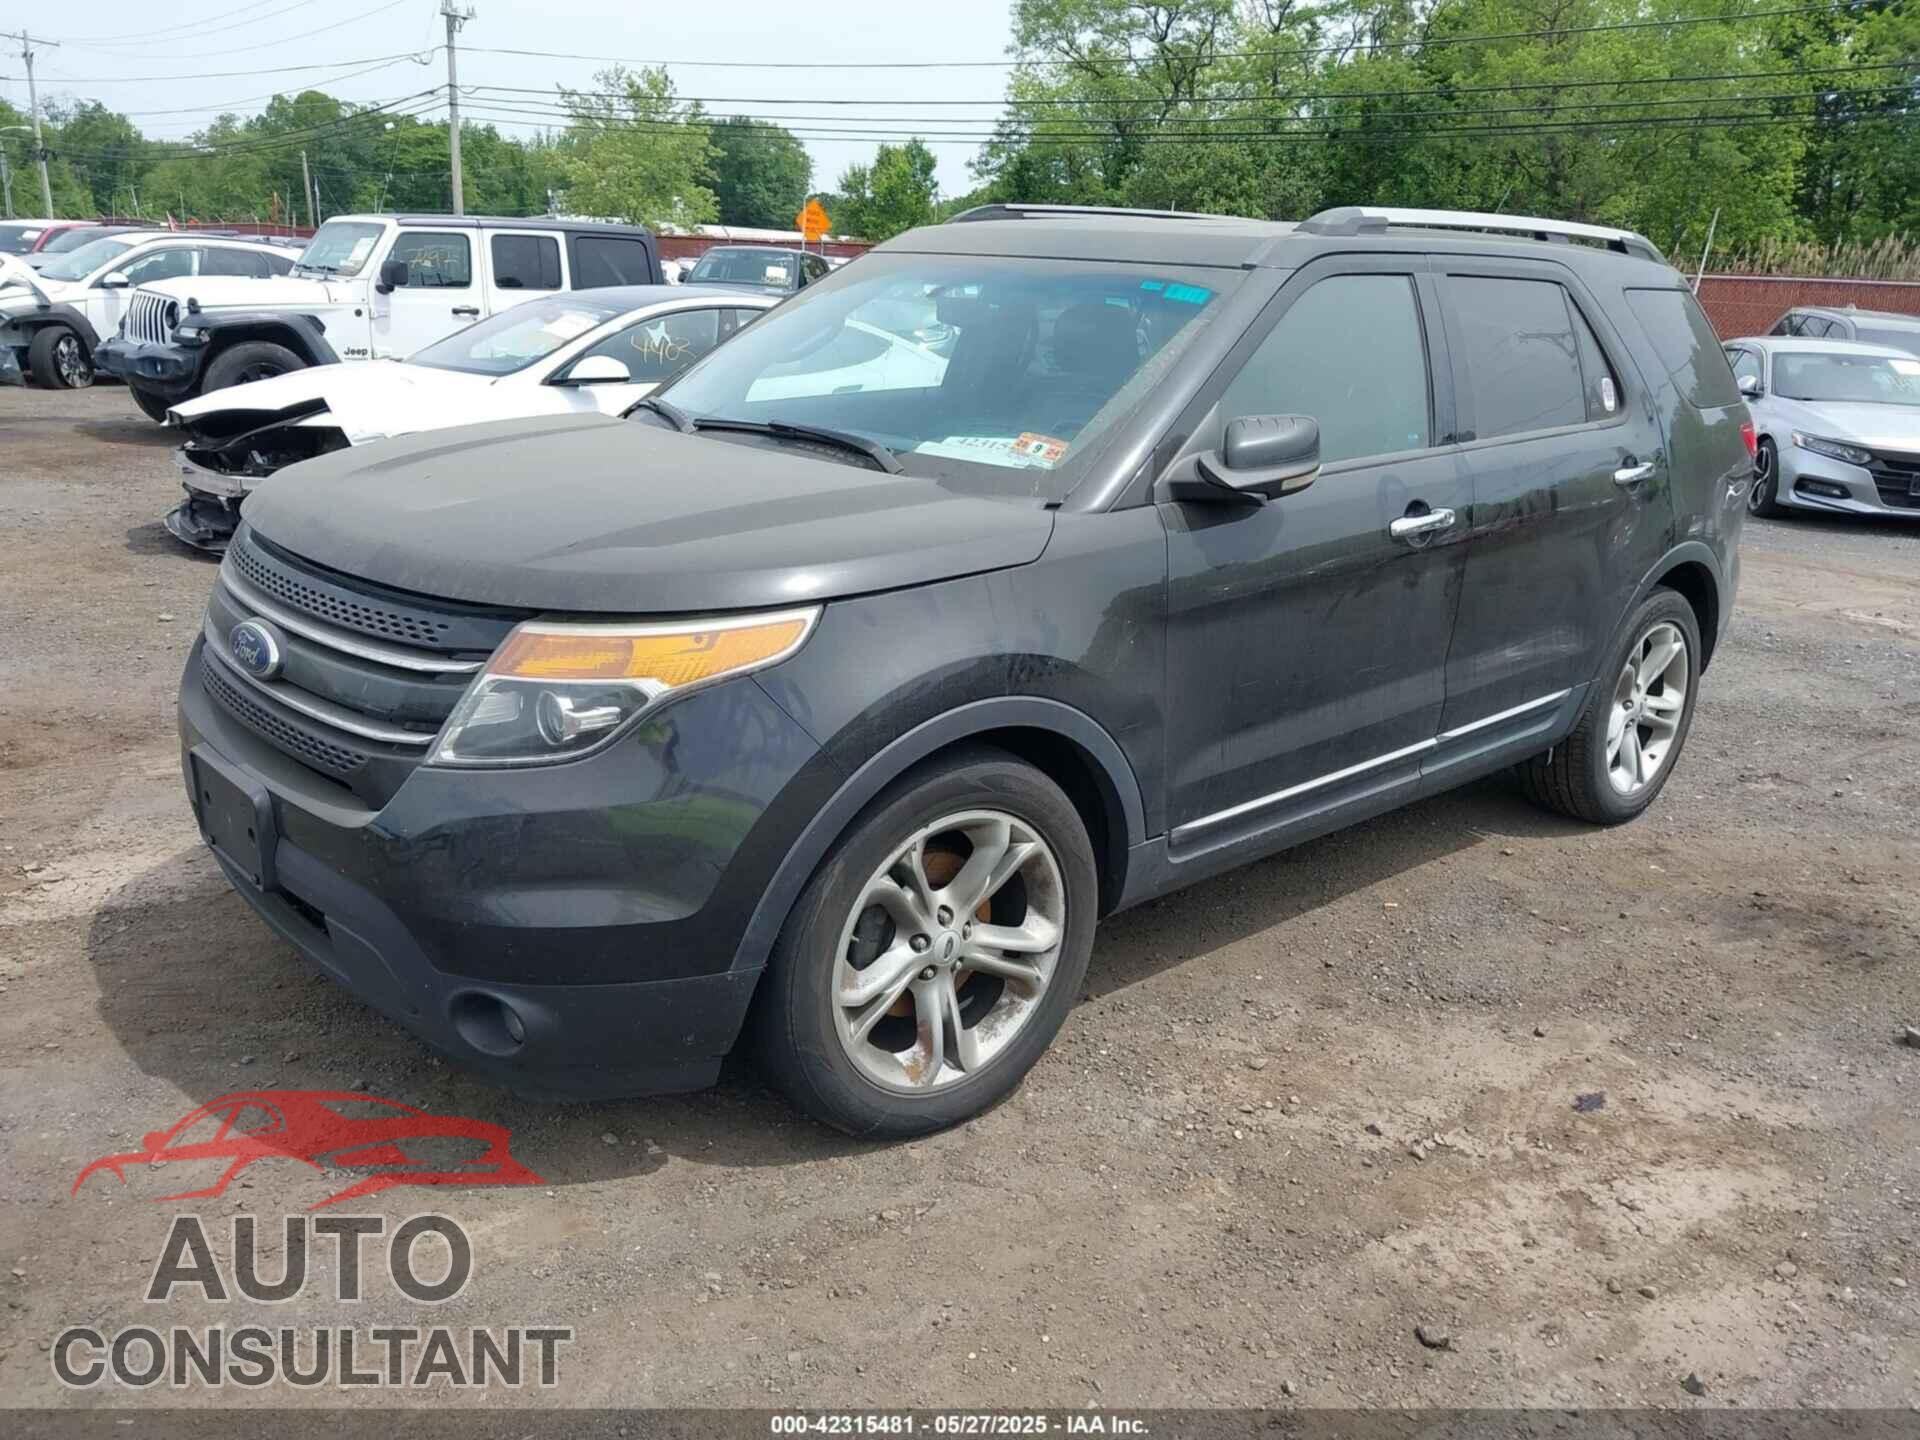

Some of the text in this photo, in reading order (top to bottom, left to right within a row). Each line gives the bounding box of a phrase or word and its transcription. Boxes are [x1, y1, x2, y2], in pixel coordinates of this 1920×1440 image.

[343, 347, 368, 356] Jeep
[1032, 443, 1043, 454] 9
[232, 630, 260, 665] Ford
